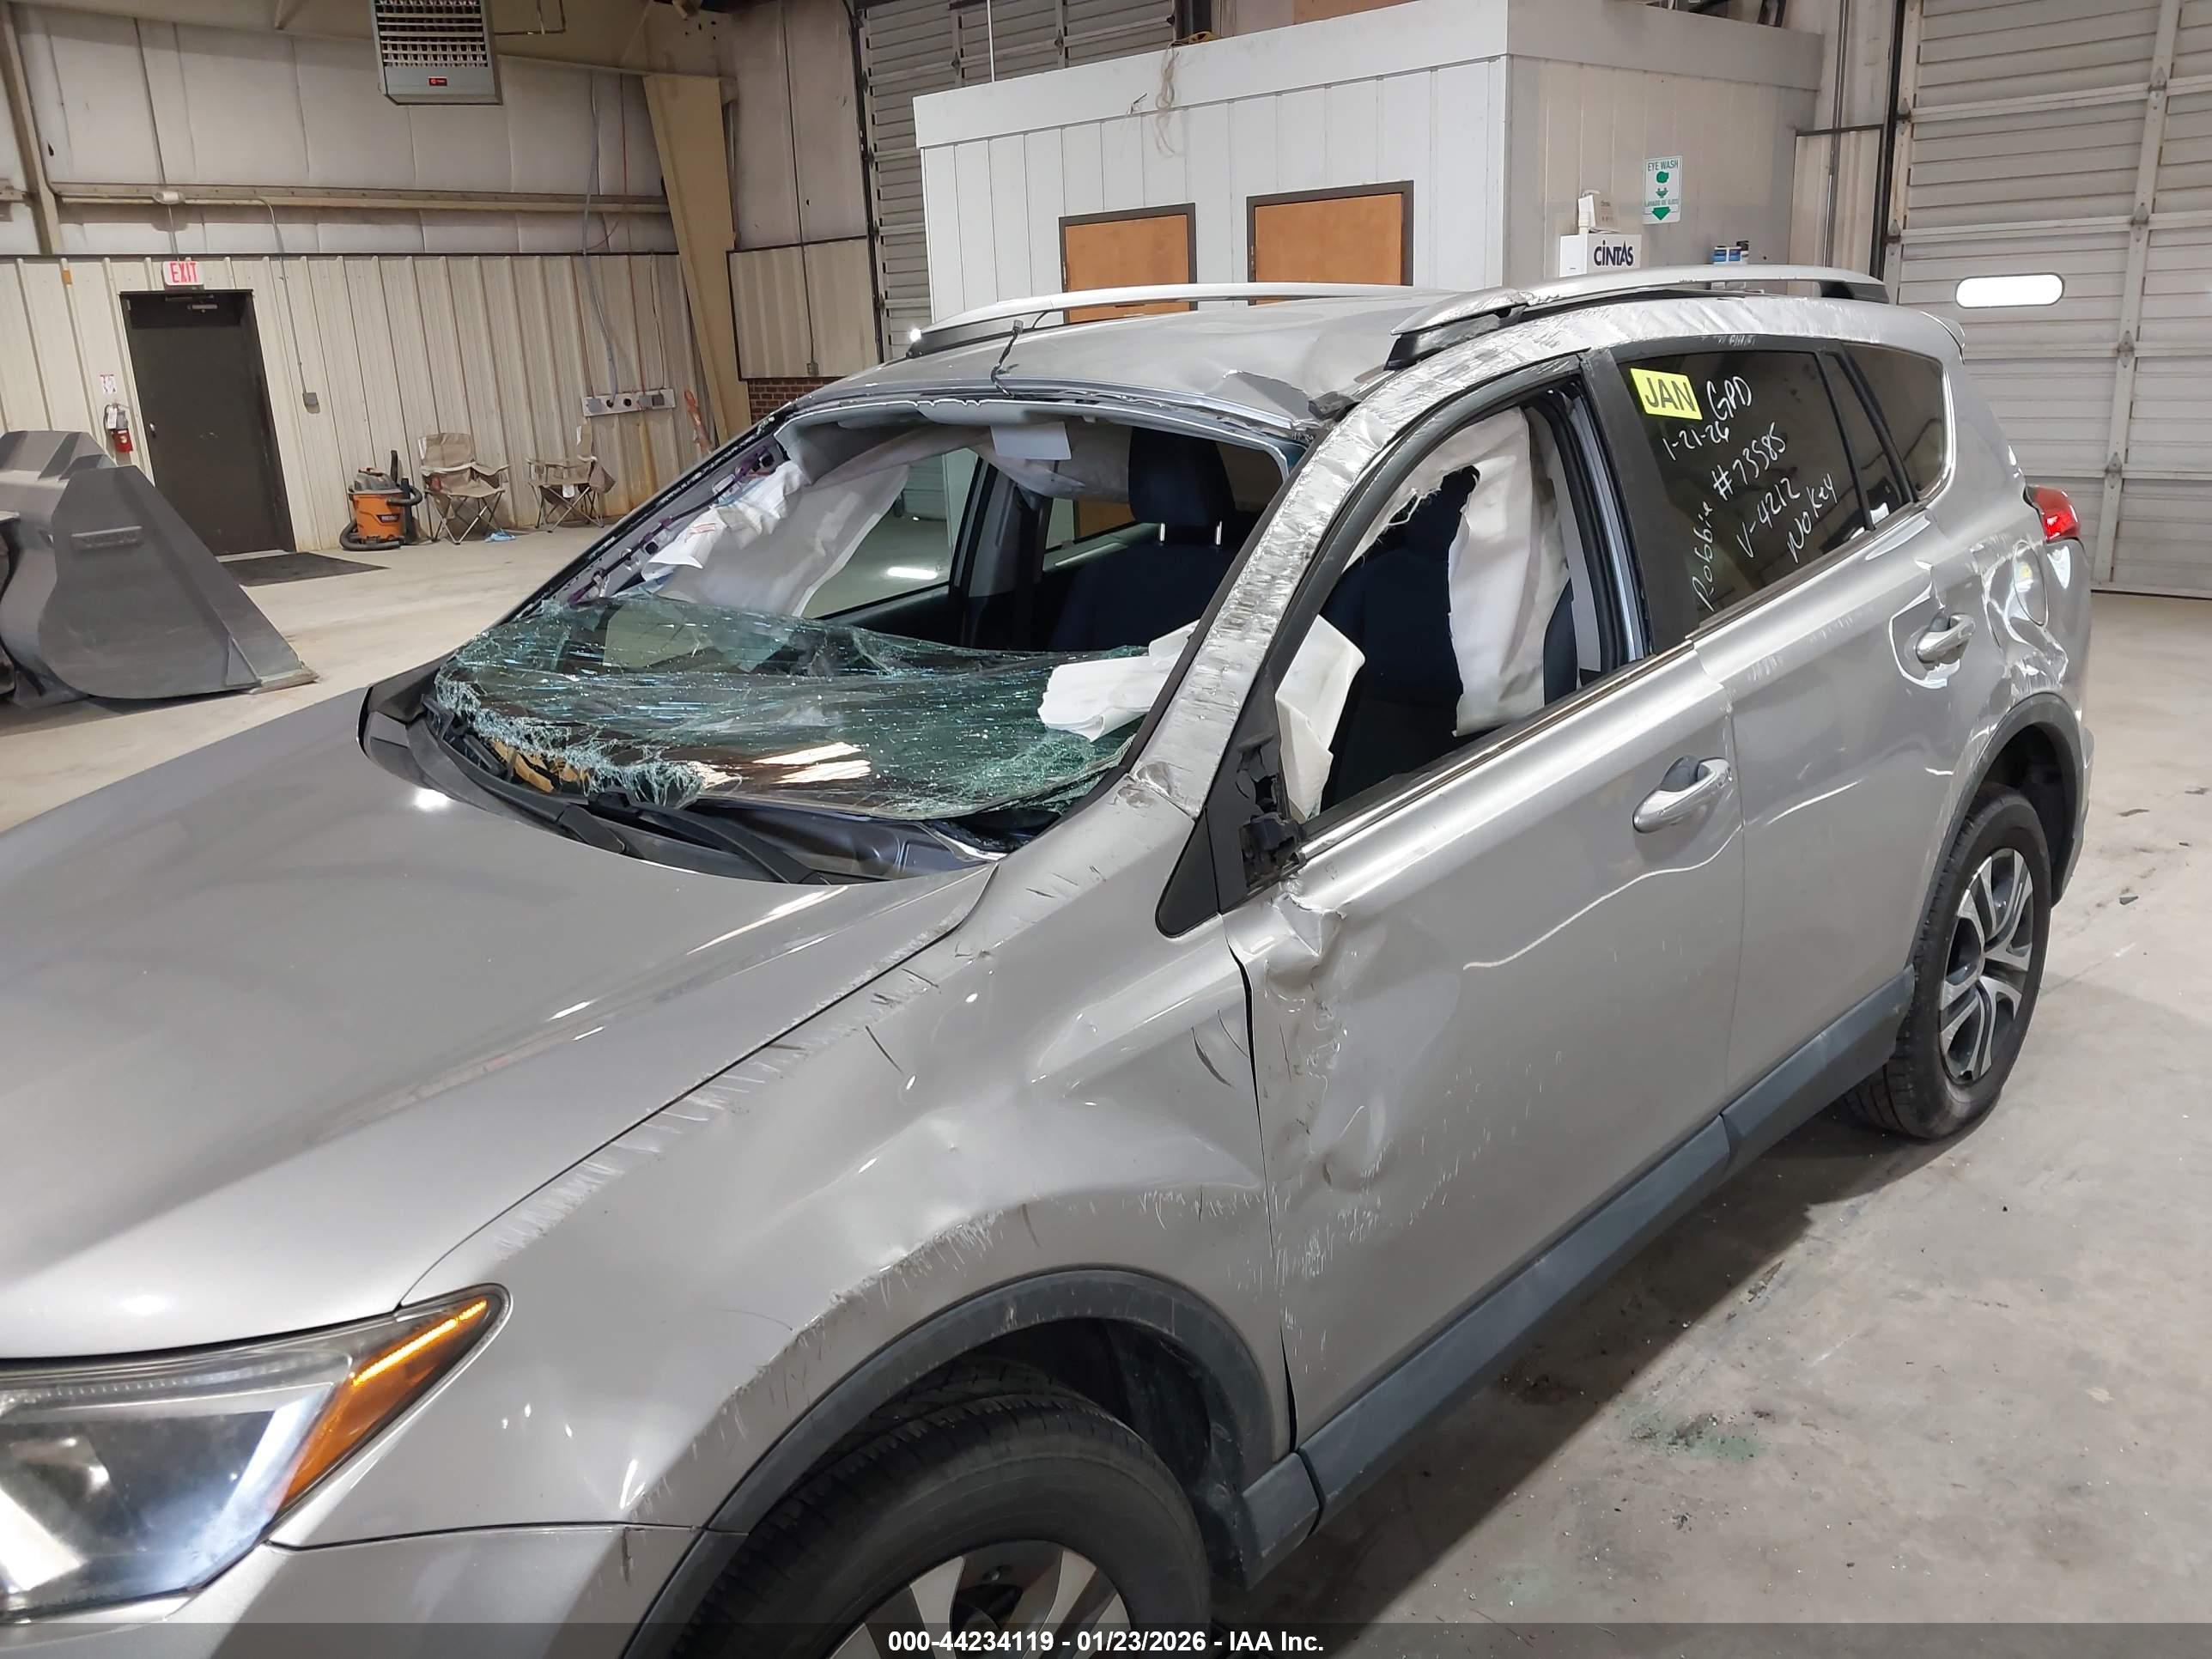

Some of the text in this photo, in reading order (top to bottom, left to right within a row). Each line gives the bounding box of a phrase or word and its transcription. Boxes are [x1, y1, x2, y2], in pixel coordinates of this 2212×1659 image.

[1648, 160, 1679, 172] EYE WASH
[1594, 240, 1634, 266] CINTAS
[170, 262, 198, 283] EXIT
[1644, 377, 1696, 412] JAN
[1662, 420, 1730, 461] 1-21-26
[1711, 421, 1787, 501] #73585
